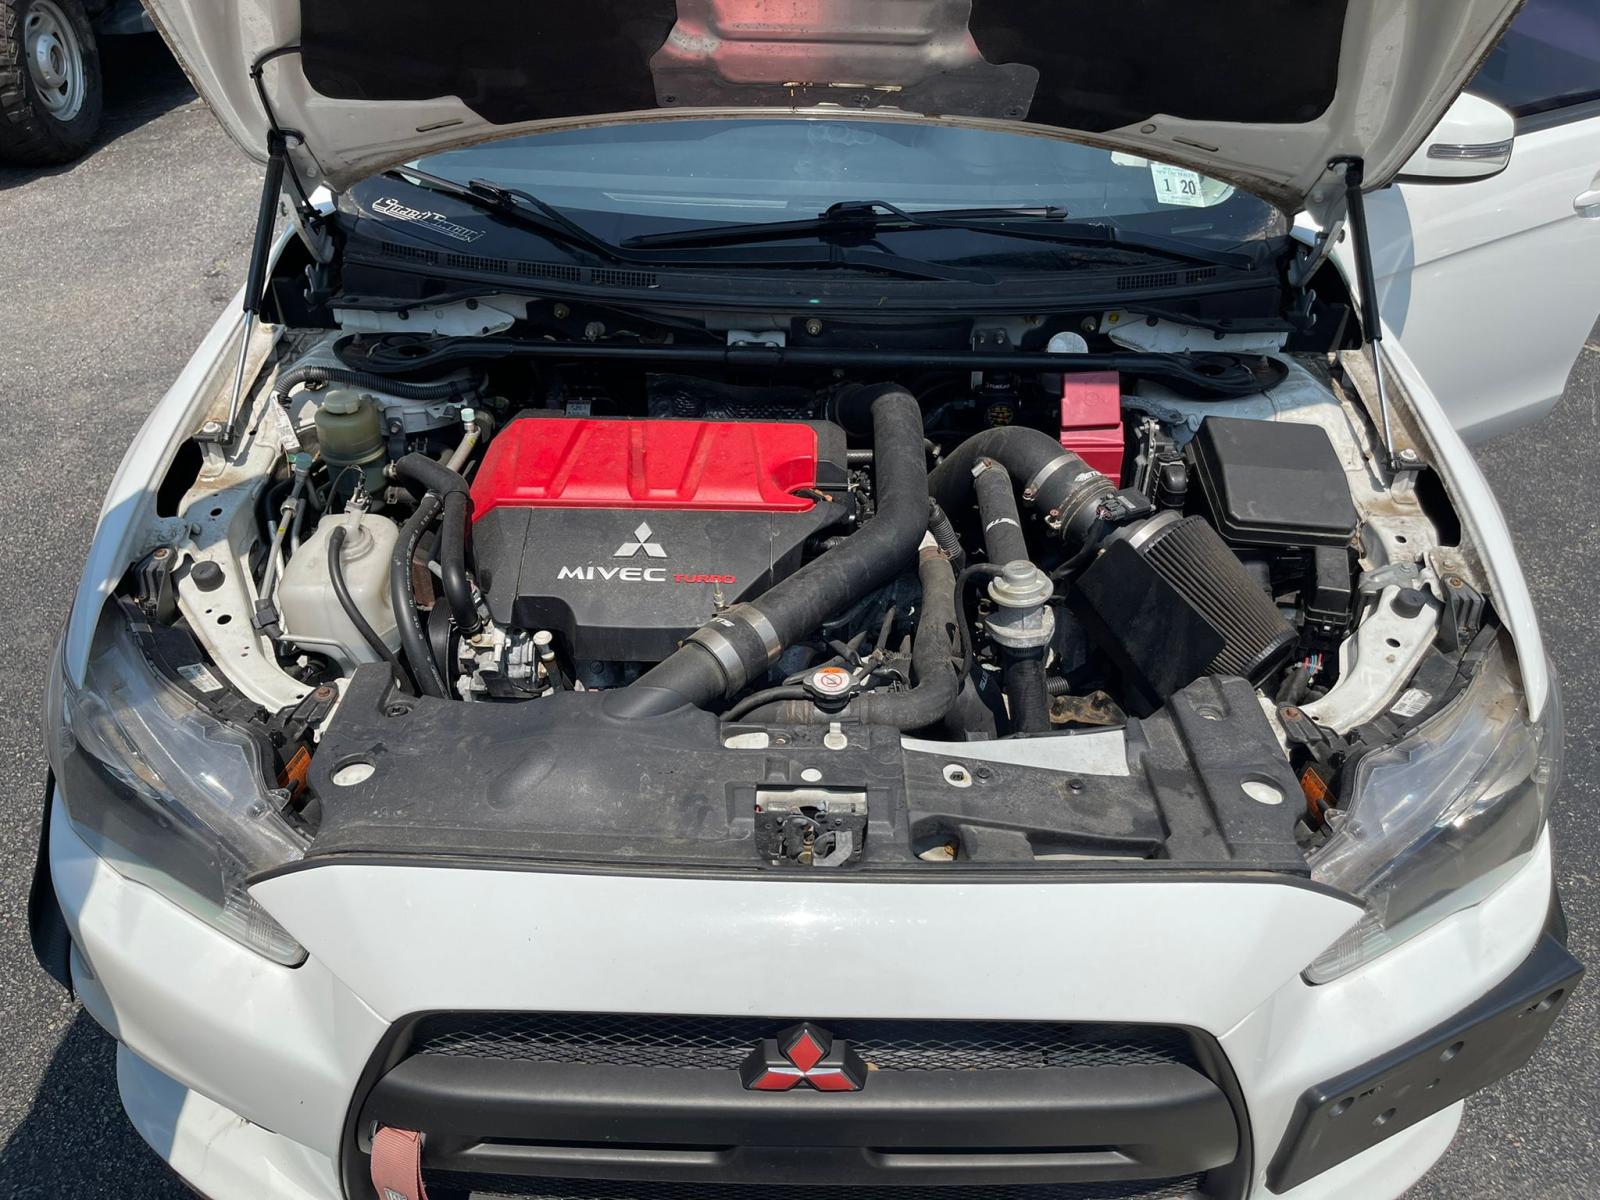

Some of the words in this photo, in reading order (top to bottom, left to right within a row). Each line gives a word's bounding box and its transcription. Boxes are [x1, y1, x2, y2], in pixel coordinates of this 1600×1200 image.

[1164, 179, 1172, 192] 1
[1180, 179, 1196, 195] 20
[673, 572, 736, 584] TURBO
